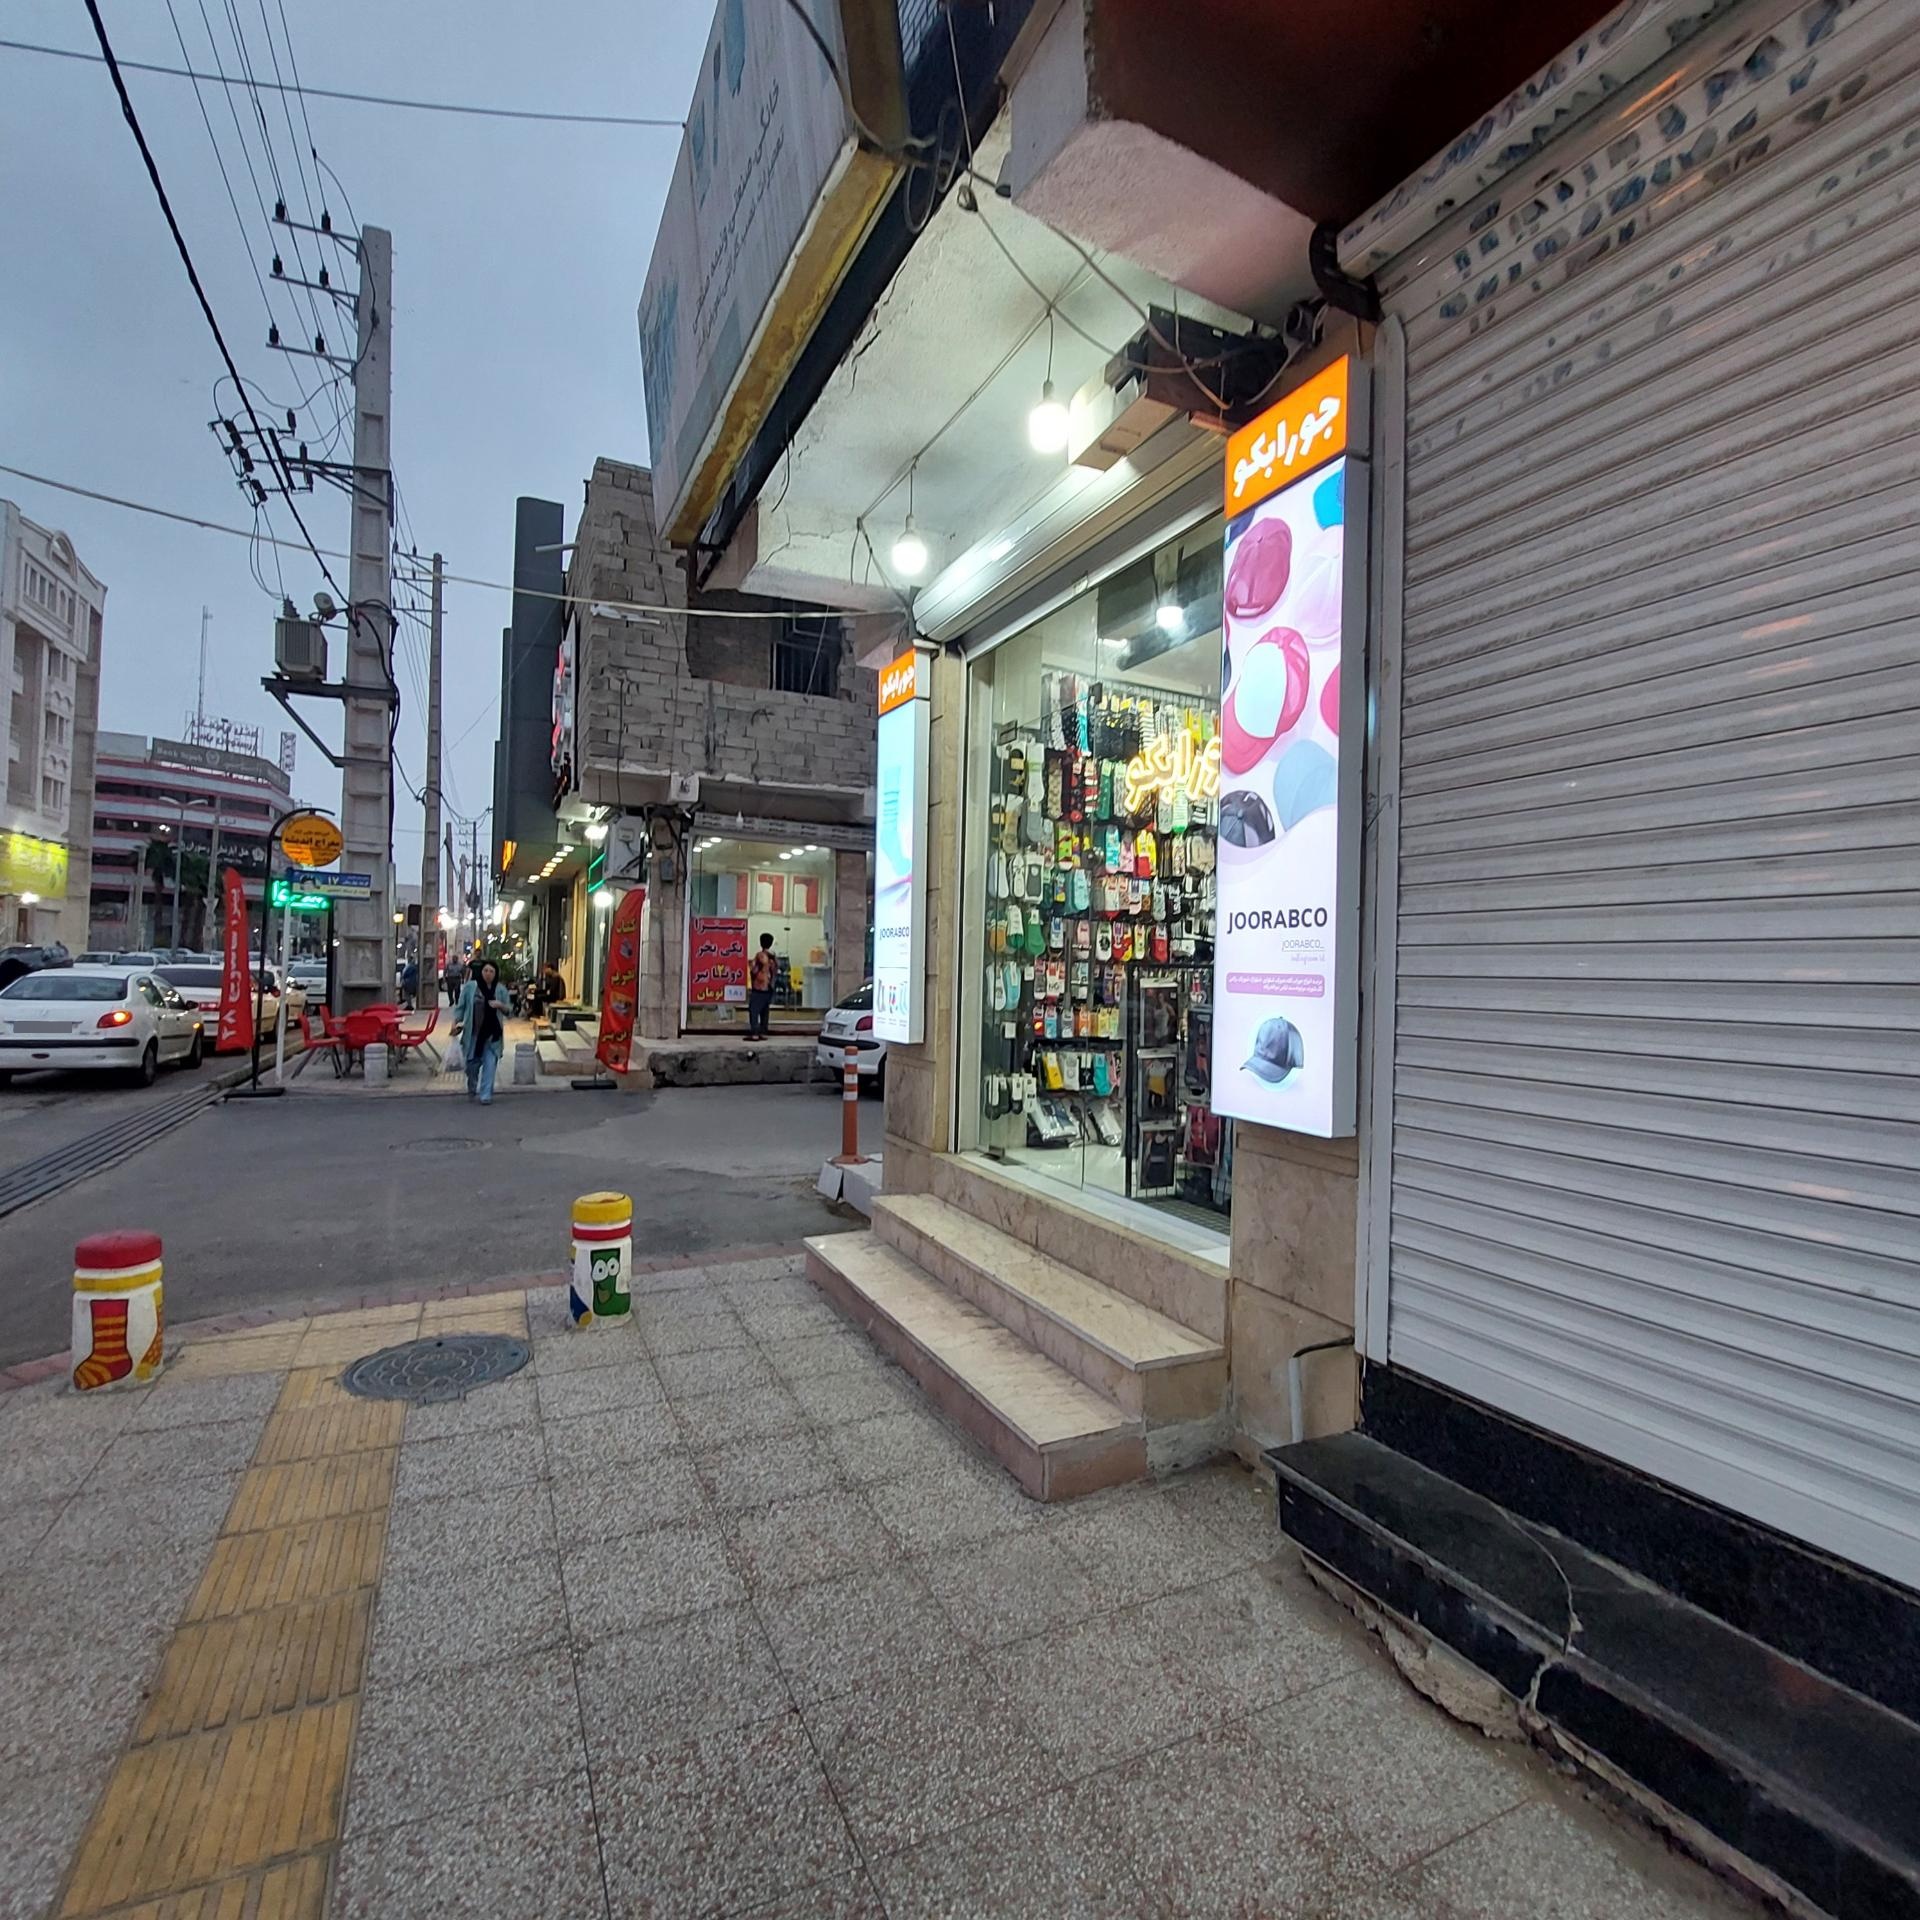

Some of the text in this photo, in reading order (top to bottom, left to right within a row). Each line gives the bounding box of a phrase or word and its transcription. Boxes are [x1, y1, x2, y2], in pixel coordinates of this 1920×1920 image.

[1233, 396, 1341, 498] جورابکو
[881, 664, 915, 705] جورابکو
[1124, 728, 1221, 813] ورابکو
[879, 926, 910, 940] JOORABCO
[1227, 907, 1328, 934] JOORABCO
[696, 940, 743, 957] یکی بخر
[696, 986, 724, 1001] تومان
